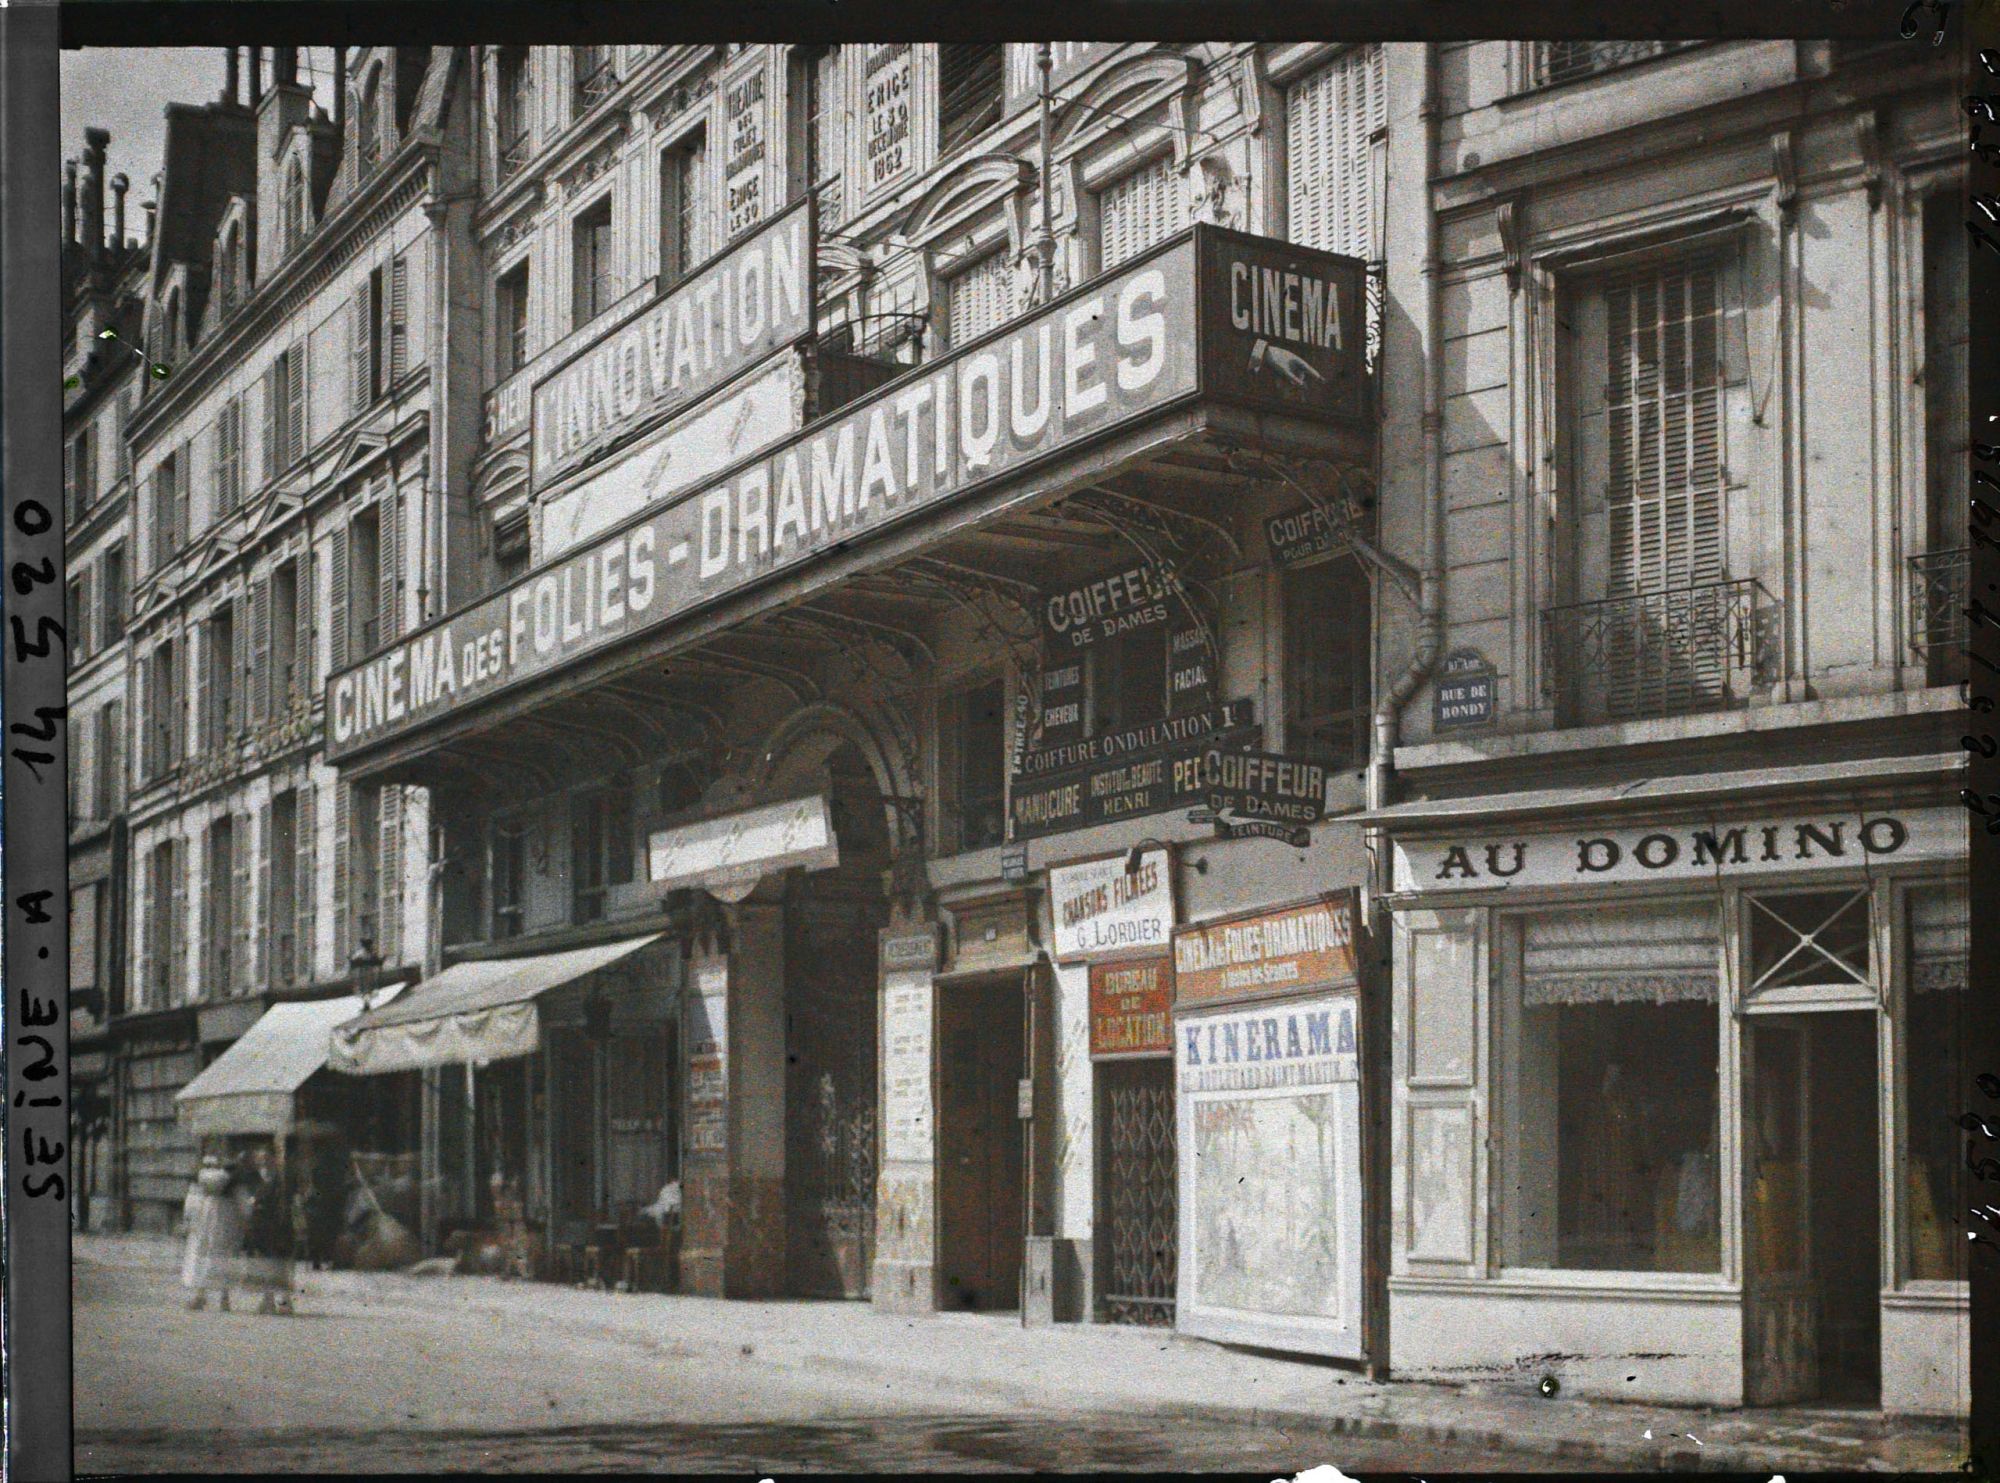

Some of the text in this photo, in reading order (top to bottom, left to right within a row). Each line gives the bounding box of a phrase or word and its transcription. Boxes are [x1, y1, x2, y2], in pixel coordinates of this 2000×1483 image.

[874, 145, 902, 182] 1862
[532, 222, 802, 470] L'INNOVATION
[334, 627, 456, 742] CINEMA
[462, 628, 503, 686] DES
[509, 522, 655, 665] FOLIES
[700, 268, 1166, 580] DRAMATIQUES
[1072, 604, 1169, 647] DE DAMES
[1441, 684, 1487, 701] RUE DE
[1442, 702, 1487, 719] BONDY
[1025, 741, 1097, 774] COIFFURE
[1103, 712, 1213, 756] ONDULATION
[1204, 749, 1324, 801] COIFFEUR
[1246, 794, 1317, 822] DAMES
[1435, 817, 1911, 880] AU DOMINO
[1095, 919, 1162, 947] LORDIER
[1186, 1008, 1358, 1066] KINERAMA
